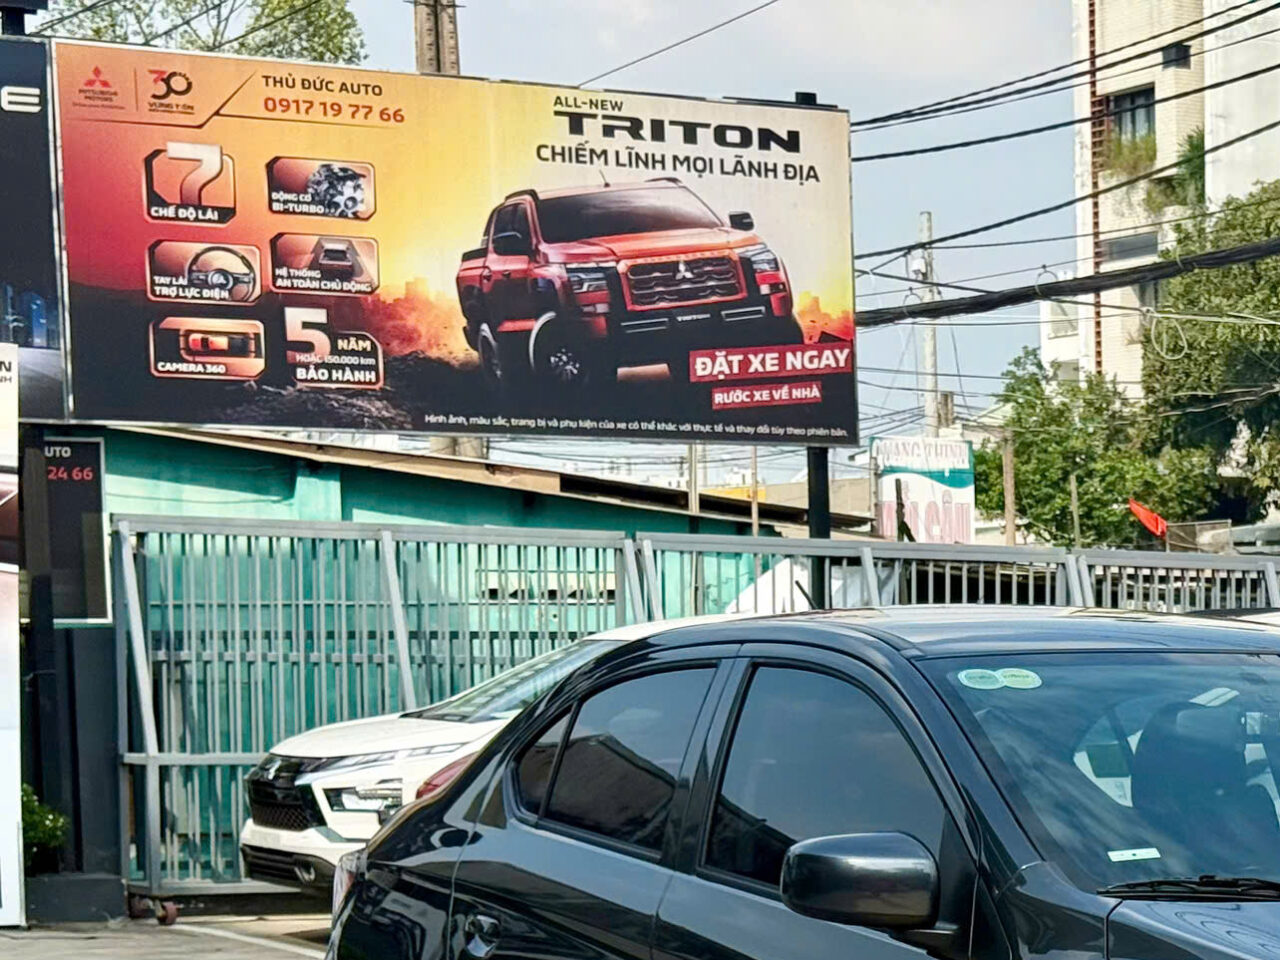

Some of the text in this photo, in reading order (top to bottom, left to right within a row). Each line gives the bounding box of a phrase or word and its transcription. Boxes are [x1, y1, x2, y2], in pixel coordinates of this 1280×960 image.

[148, 68, 193, 100] 30
[262, 73, 383, 97] THỦ ĐỨC AUTO
[264, 97, 405, 123] 0917 19 77 66
[553, 95, 624, 112] ALL-NEW
[553, 110, 800, 153] TRITON
[536, 140, 821, 186] CHIẾM LĨNH MỌI LÃNH ĐỊA
[166, 141, 224, 206] 7
[271, 191, 298, 202] ĐỘNG
[150, 204, 219, 221] CHẾ ĐỘ LÁI
[272, 202, 324, 214] BI-TURBO
[153, 275, 188, 286] TAY LÁI
[275, 267, 321, 278] HỆ THỐNG
[153, 286, 230, 300] TRỢ LỰC ĐIỆN
[276, 278, 372, 293] AN TOÀN CHỦ ĐỘNG
[284, 306, 331, 364] 5
[337, 337, 372, 352] NĂM
[157, 361, 226, 375] CAMERA 360
[360, 356, 376, 365] km
[694, 348, 850, 380] ĐẶT XE NGAY
[296, 366, 376, 383] BẢO HÀNH
[714, 384, 821, 405] RƯỚC XE VỀ NHÀ
[425, 414, 447, 424] Hình
[469, 416, 490, 425] màu
[510, 417, 536, 428] trang
[537, 417, 545, 429] bị
[547, 418, 559, 427] và
[598, 419, 615, 429] của
[616, 421, 627, 430] xe
[628, 420, 639, 430] có
[724, 424, 735, 433] và
[736, 425, 755, 436] thay
[786, 426, 806, 436] theo
[71, 466, 94, 481] 66
